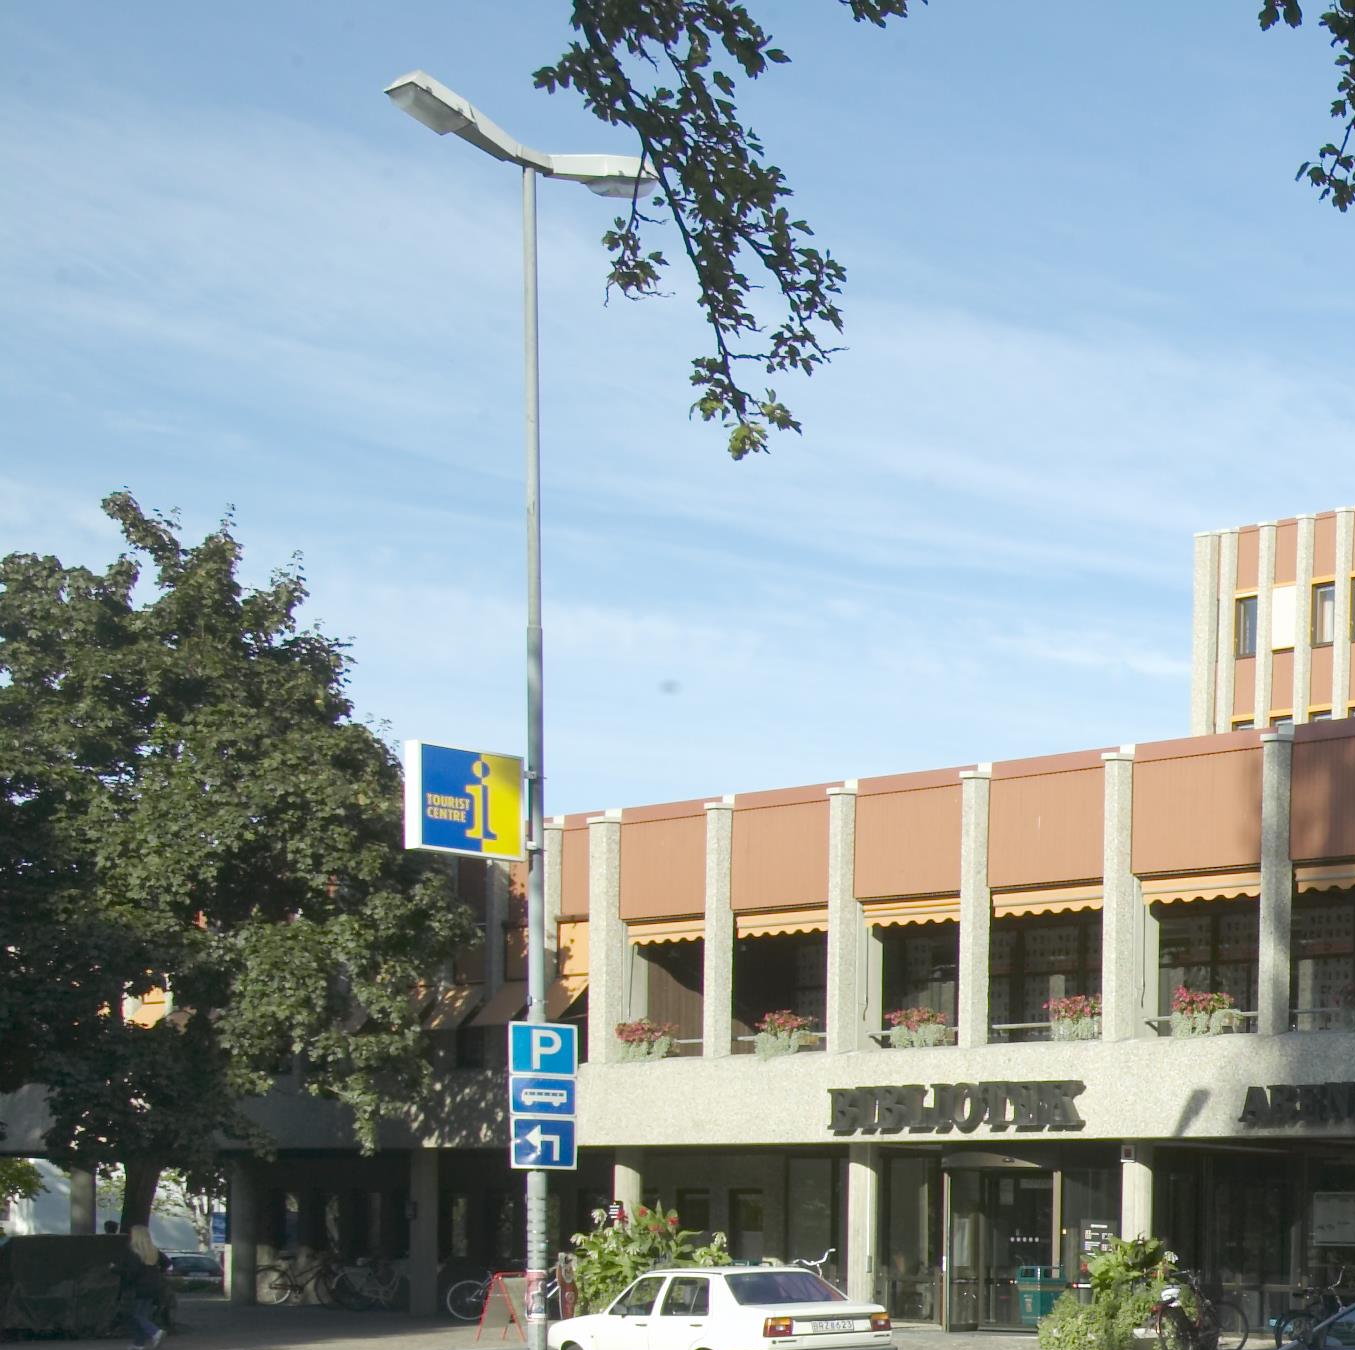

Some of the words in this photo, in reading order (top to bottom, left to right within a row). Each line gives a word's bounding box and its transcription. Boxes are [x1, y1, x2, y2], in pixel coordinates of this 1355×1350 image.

[426, 793, 471, 810] TOURIST
[426, 806, 467, 823] CENTRE
[531, 1028, 563, 1070] P
[827, 1080, 1087, 1134] BIBLIOTEK
